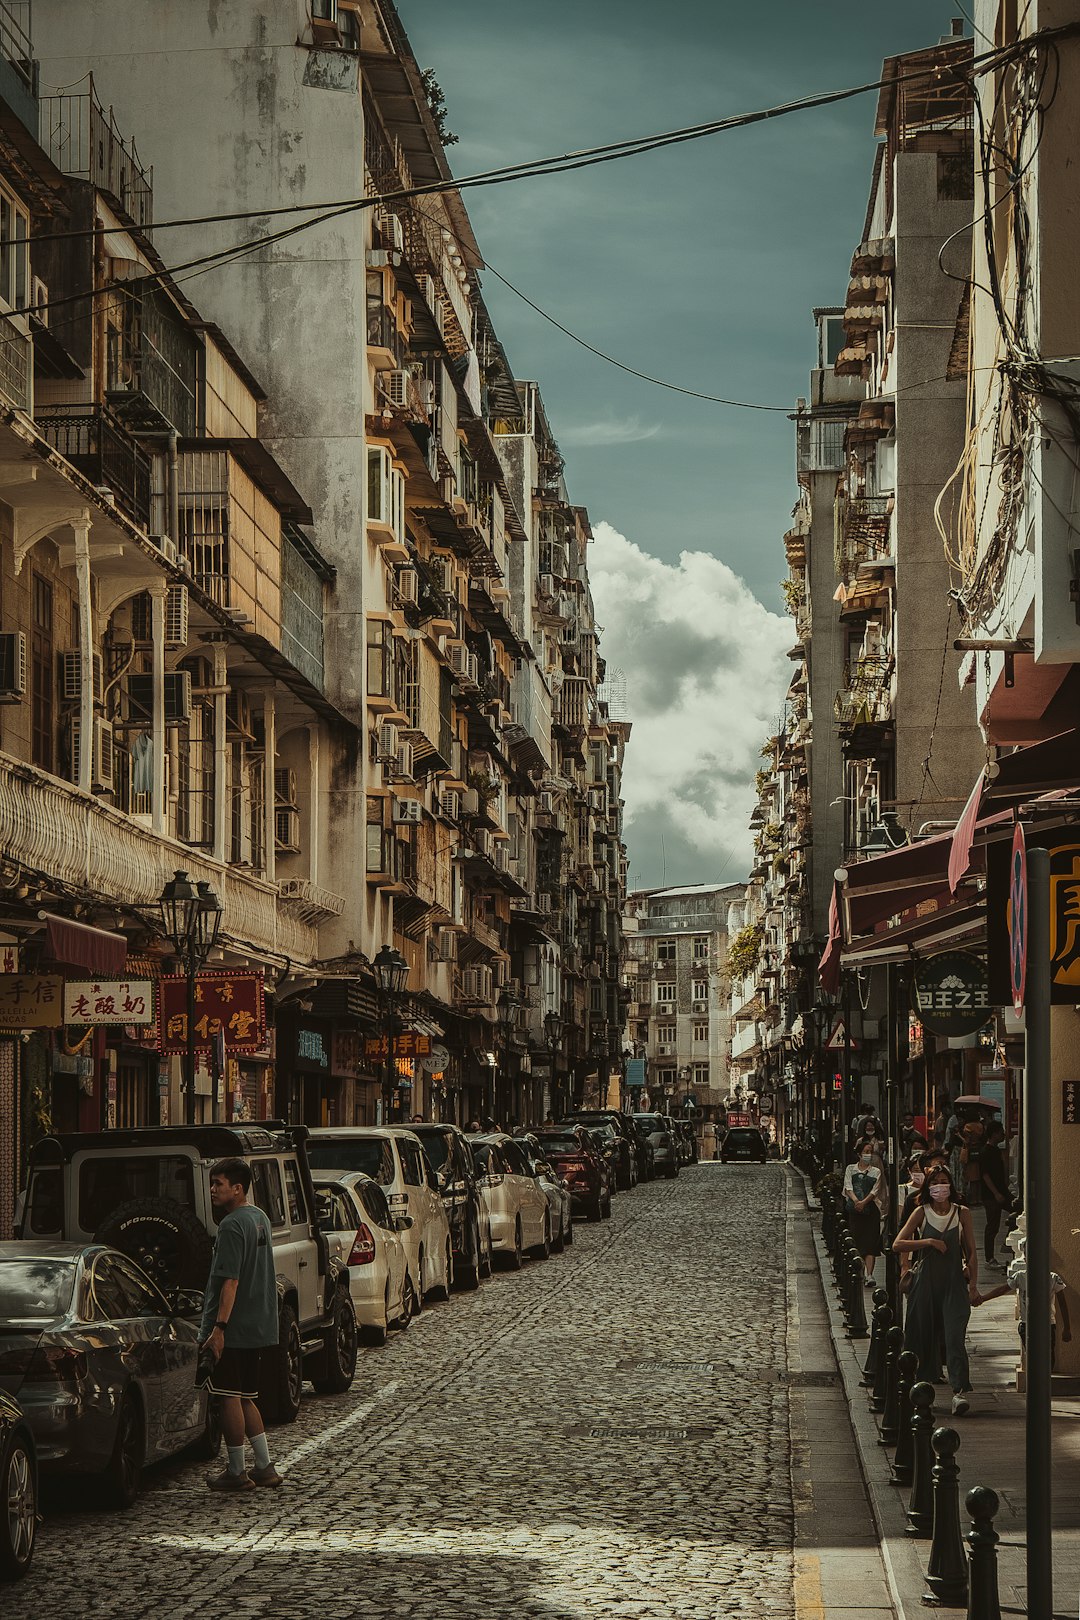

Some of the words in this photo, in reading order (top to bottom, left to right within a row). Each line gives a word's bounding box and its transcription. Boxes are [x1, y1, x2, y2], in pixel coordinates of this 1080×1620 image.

[5, 980, 58, 1005] 手信
[90, 983, 130, 994] 澳門
[70, 994, 146, 1018] 老酸奶
[0, 1015, 26, 1024] NÇAS
[167, 1010, 255, 1042] 同仁堂
[120, 1216, 179, 1233] BFGoodrich
